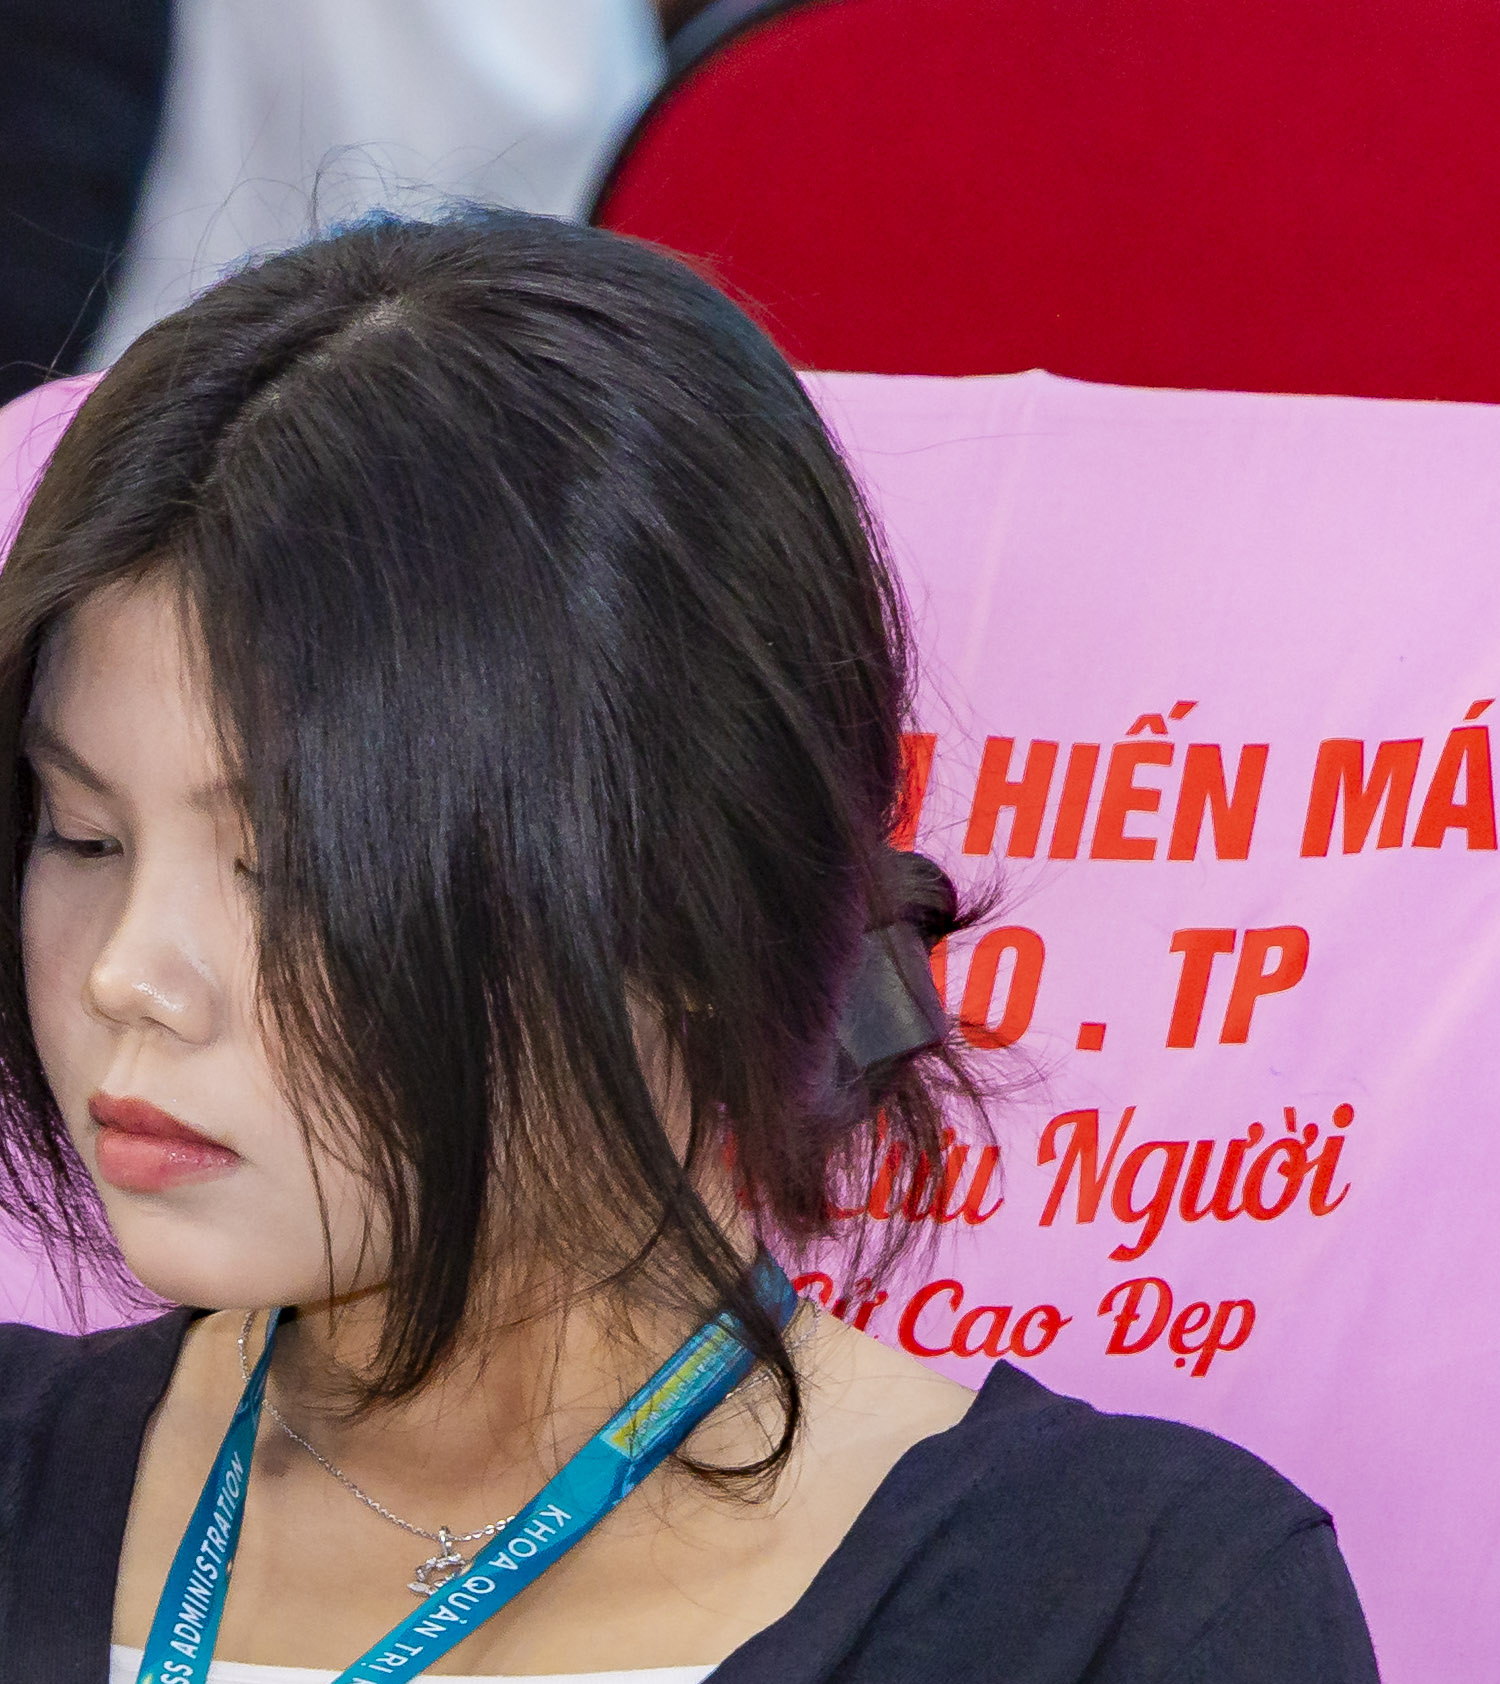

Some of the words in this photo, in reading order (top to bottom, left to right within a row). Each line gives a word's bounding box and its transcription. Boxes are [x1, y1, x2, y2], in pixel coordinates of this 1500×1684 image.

[962, 700, 1269, 861] HIẾN
[1166, 926, 1310, 1049] TP
[1036, 1103, 1355, 1262] Người
[897, 1279, 1073, 1359] Cao
[1097, 1277, 1257, 1378] Đẹp
[170, 1451, 244, 1659] ADMINISTRATION
[488, 1504, 572, 1571] KHOA
[360, 1642, 424, 1674] TRỊ
[412, 1576, 496, 1639] QUẢN
